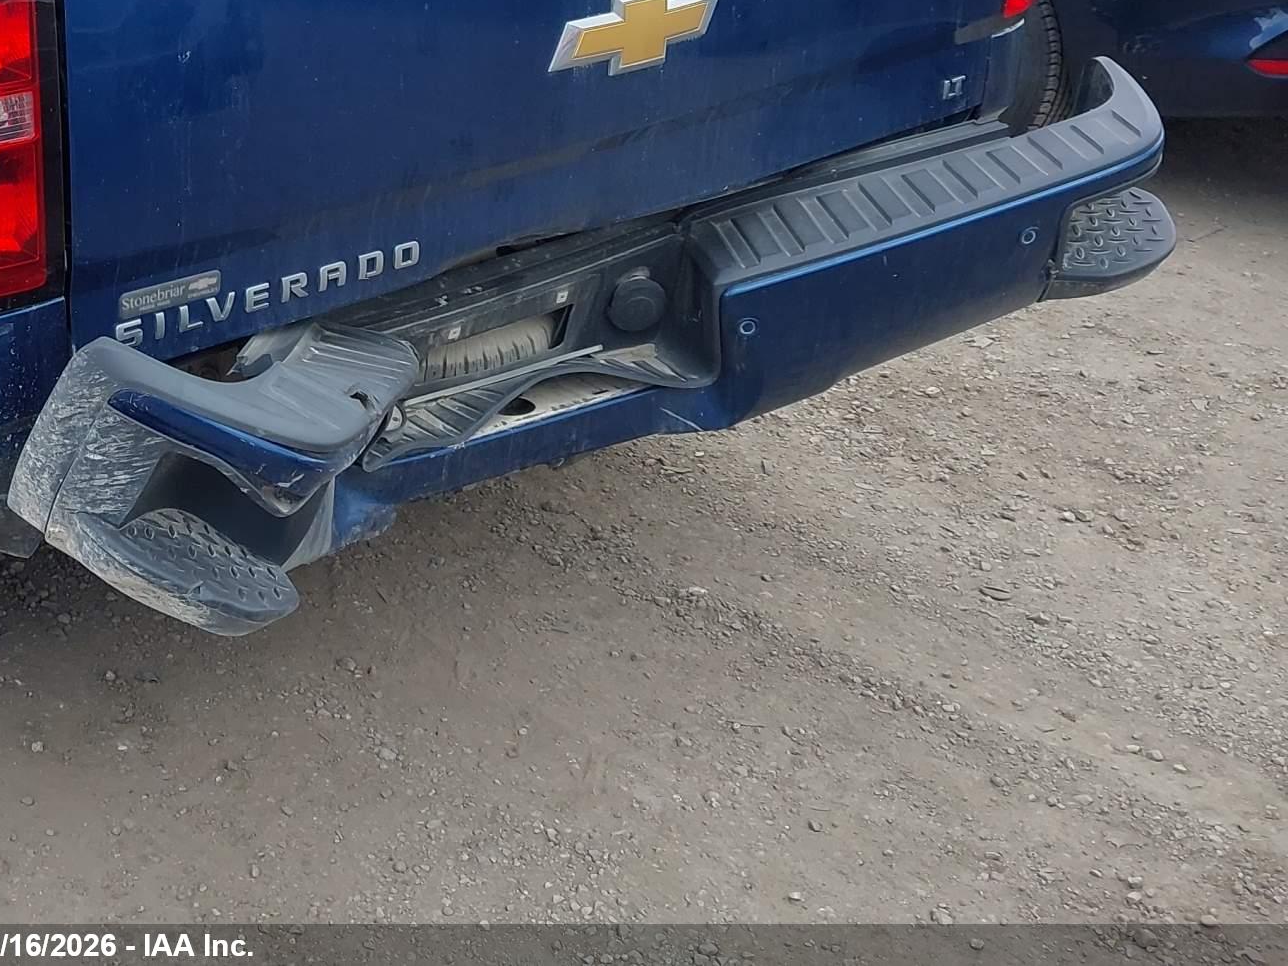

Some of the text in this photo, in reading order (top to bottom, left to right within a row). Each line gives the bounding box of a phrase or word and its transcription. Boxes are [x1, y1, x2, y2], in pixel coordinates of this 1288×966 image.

[942, 75, 966, 100] LT
[116, 240, 421, 348] SILVERADO
[121, 284, 186, 311] Stonebriar
